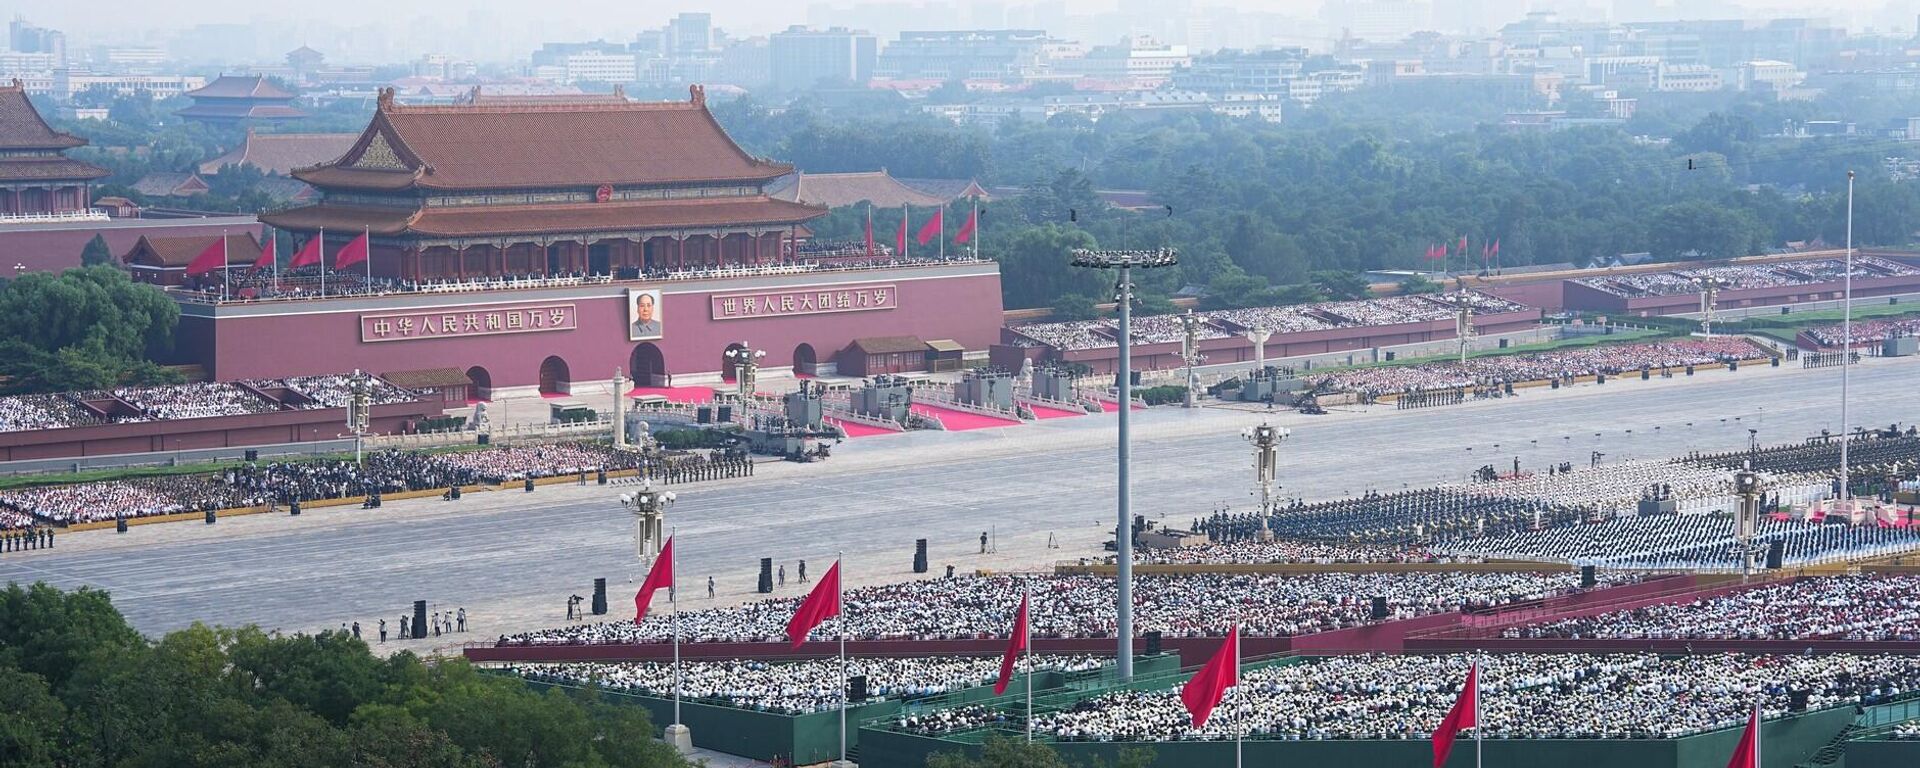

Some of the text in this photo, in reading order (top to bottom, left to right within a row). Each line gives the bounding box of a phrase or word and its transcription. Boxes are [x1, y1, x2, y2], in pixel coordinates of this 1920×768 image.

[722, 289, 888, 316] 世界人民大团结万岁
[373, 309, 565, 337] 中华人民共和国万岁
